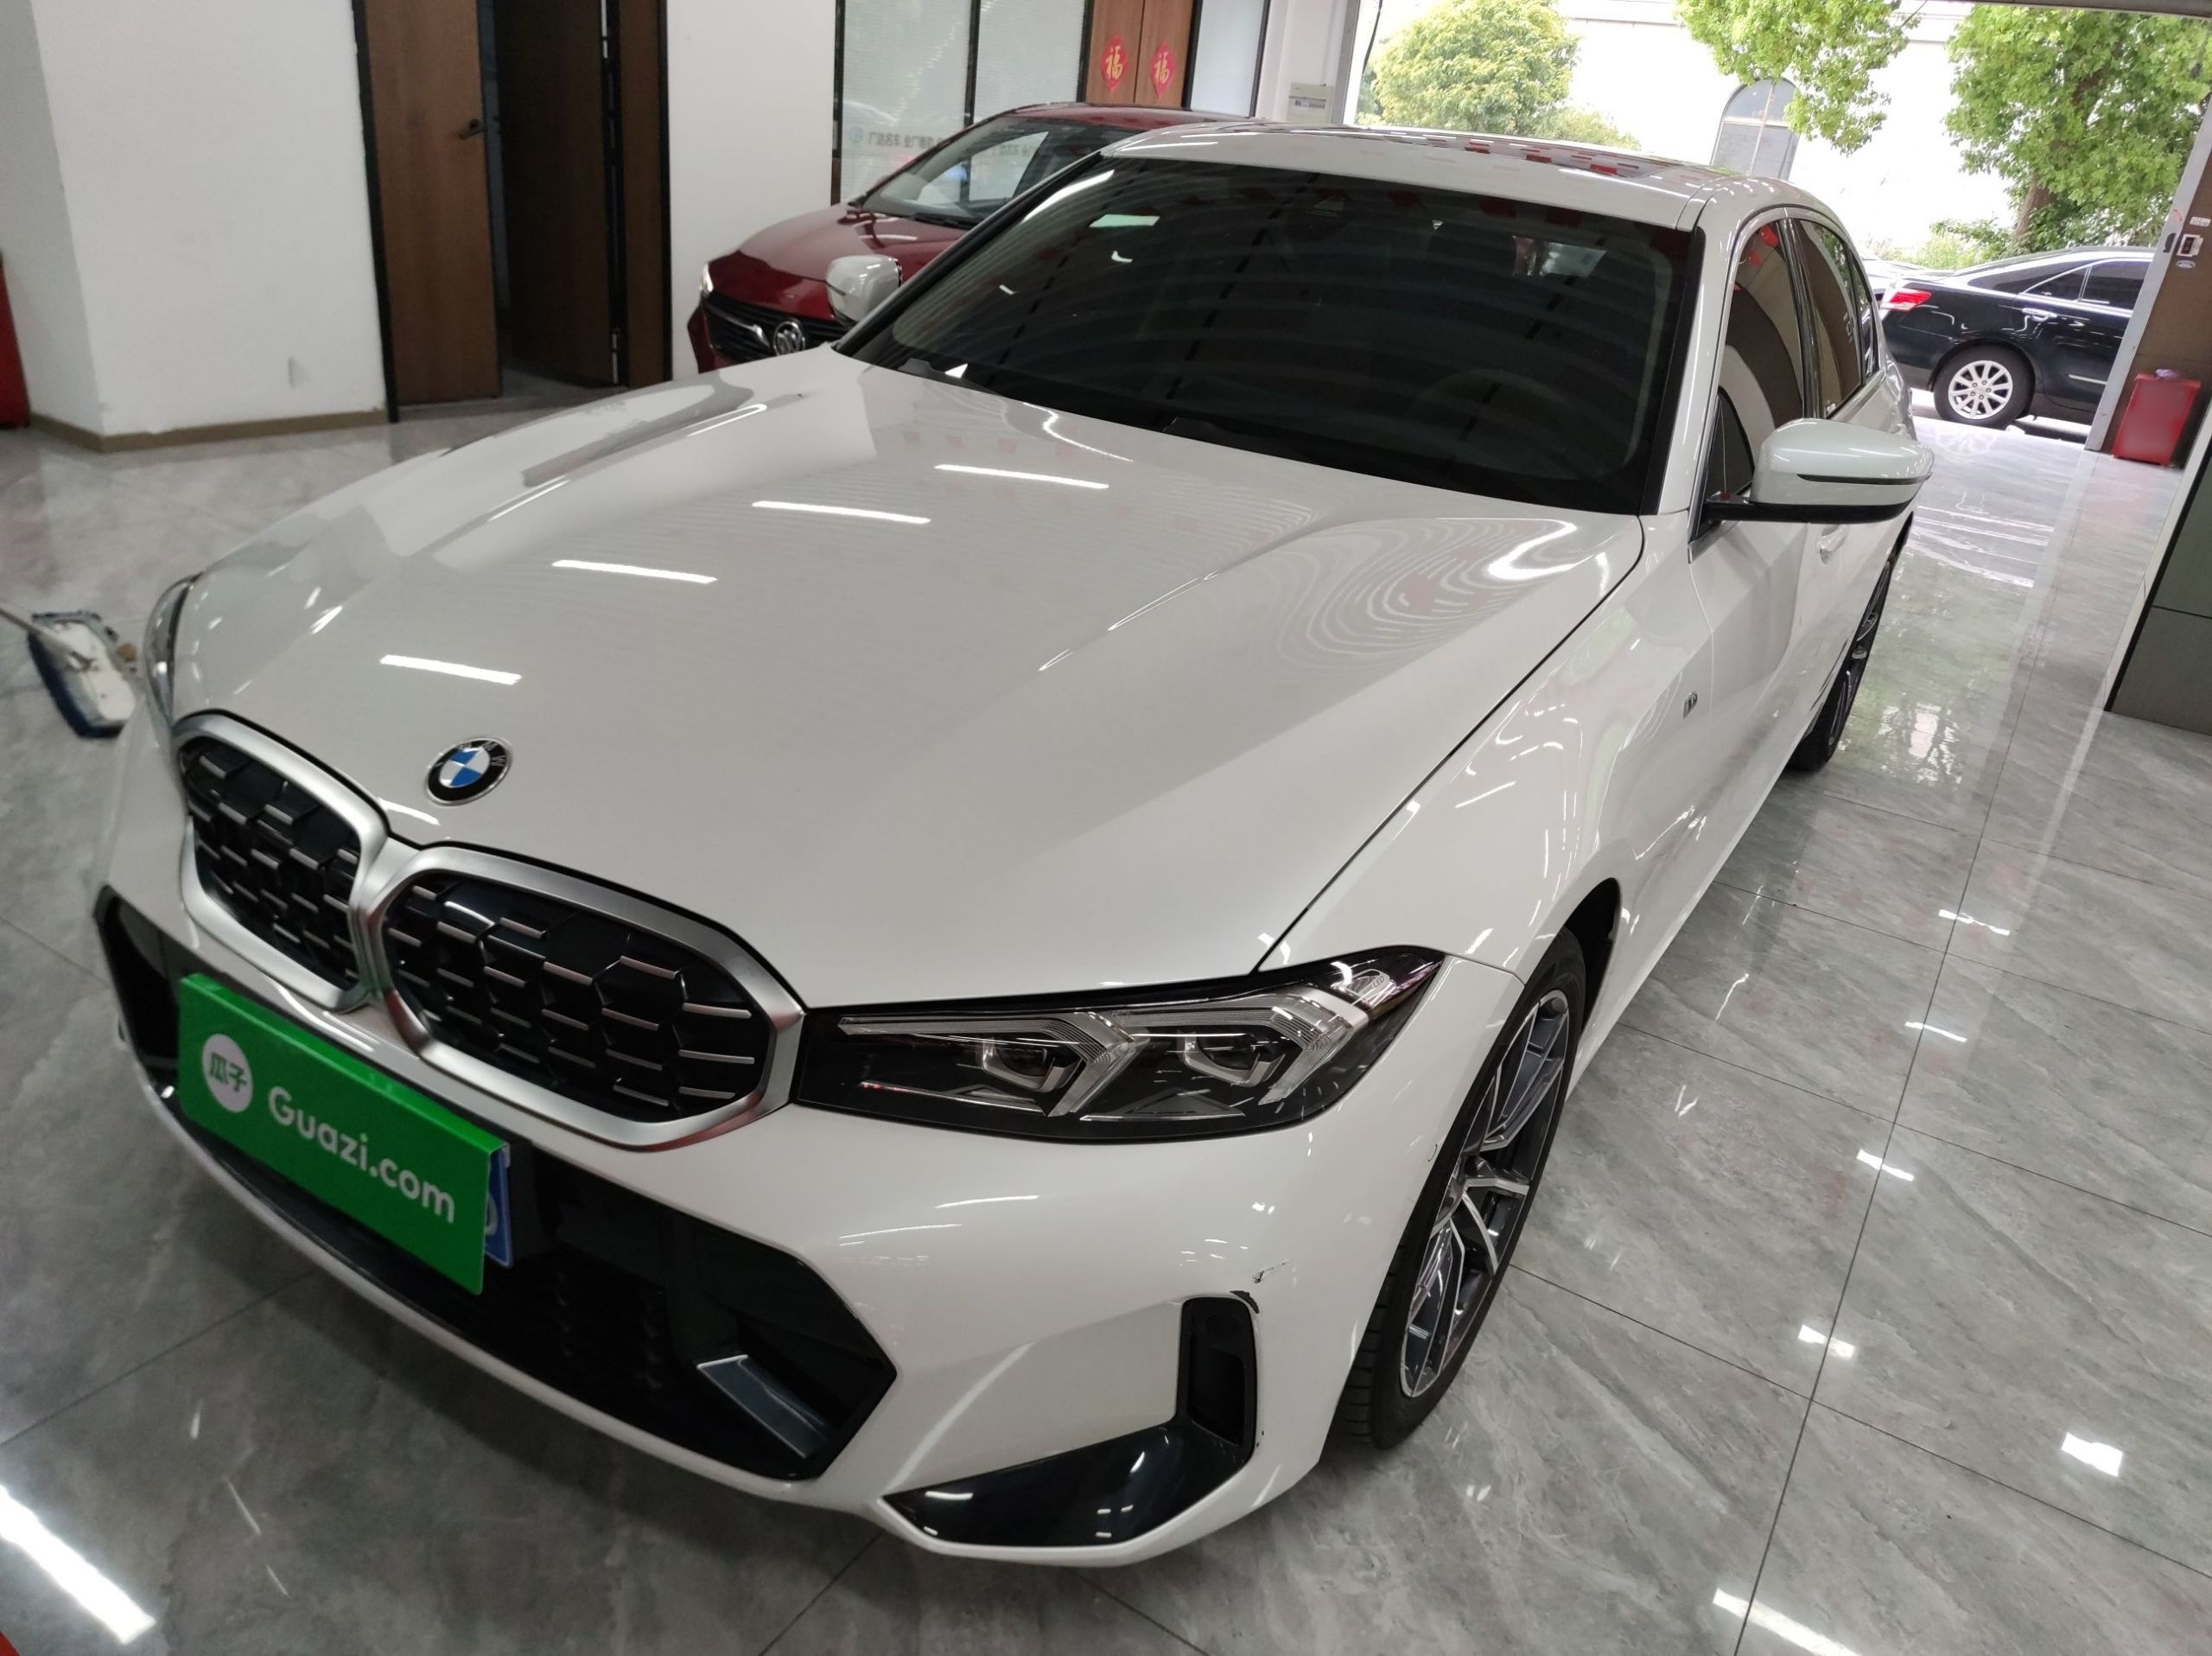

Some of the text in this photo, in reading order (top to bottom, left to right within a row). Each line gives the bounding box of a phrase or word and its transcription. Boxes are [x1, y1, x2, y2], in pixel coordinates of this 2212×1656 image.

[1105, 45, 1123, 80] 福
[1154, 51, 1170, 84] 福
[209, 1052, 247, 1092] 瓜子
[267, 1086, 455, 1225] Guazi.com
